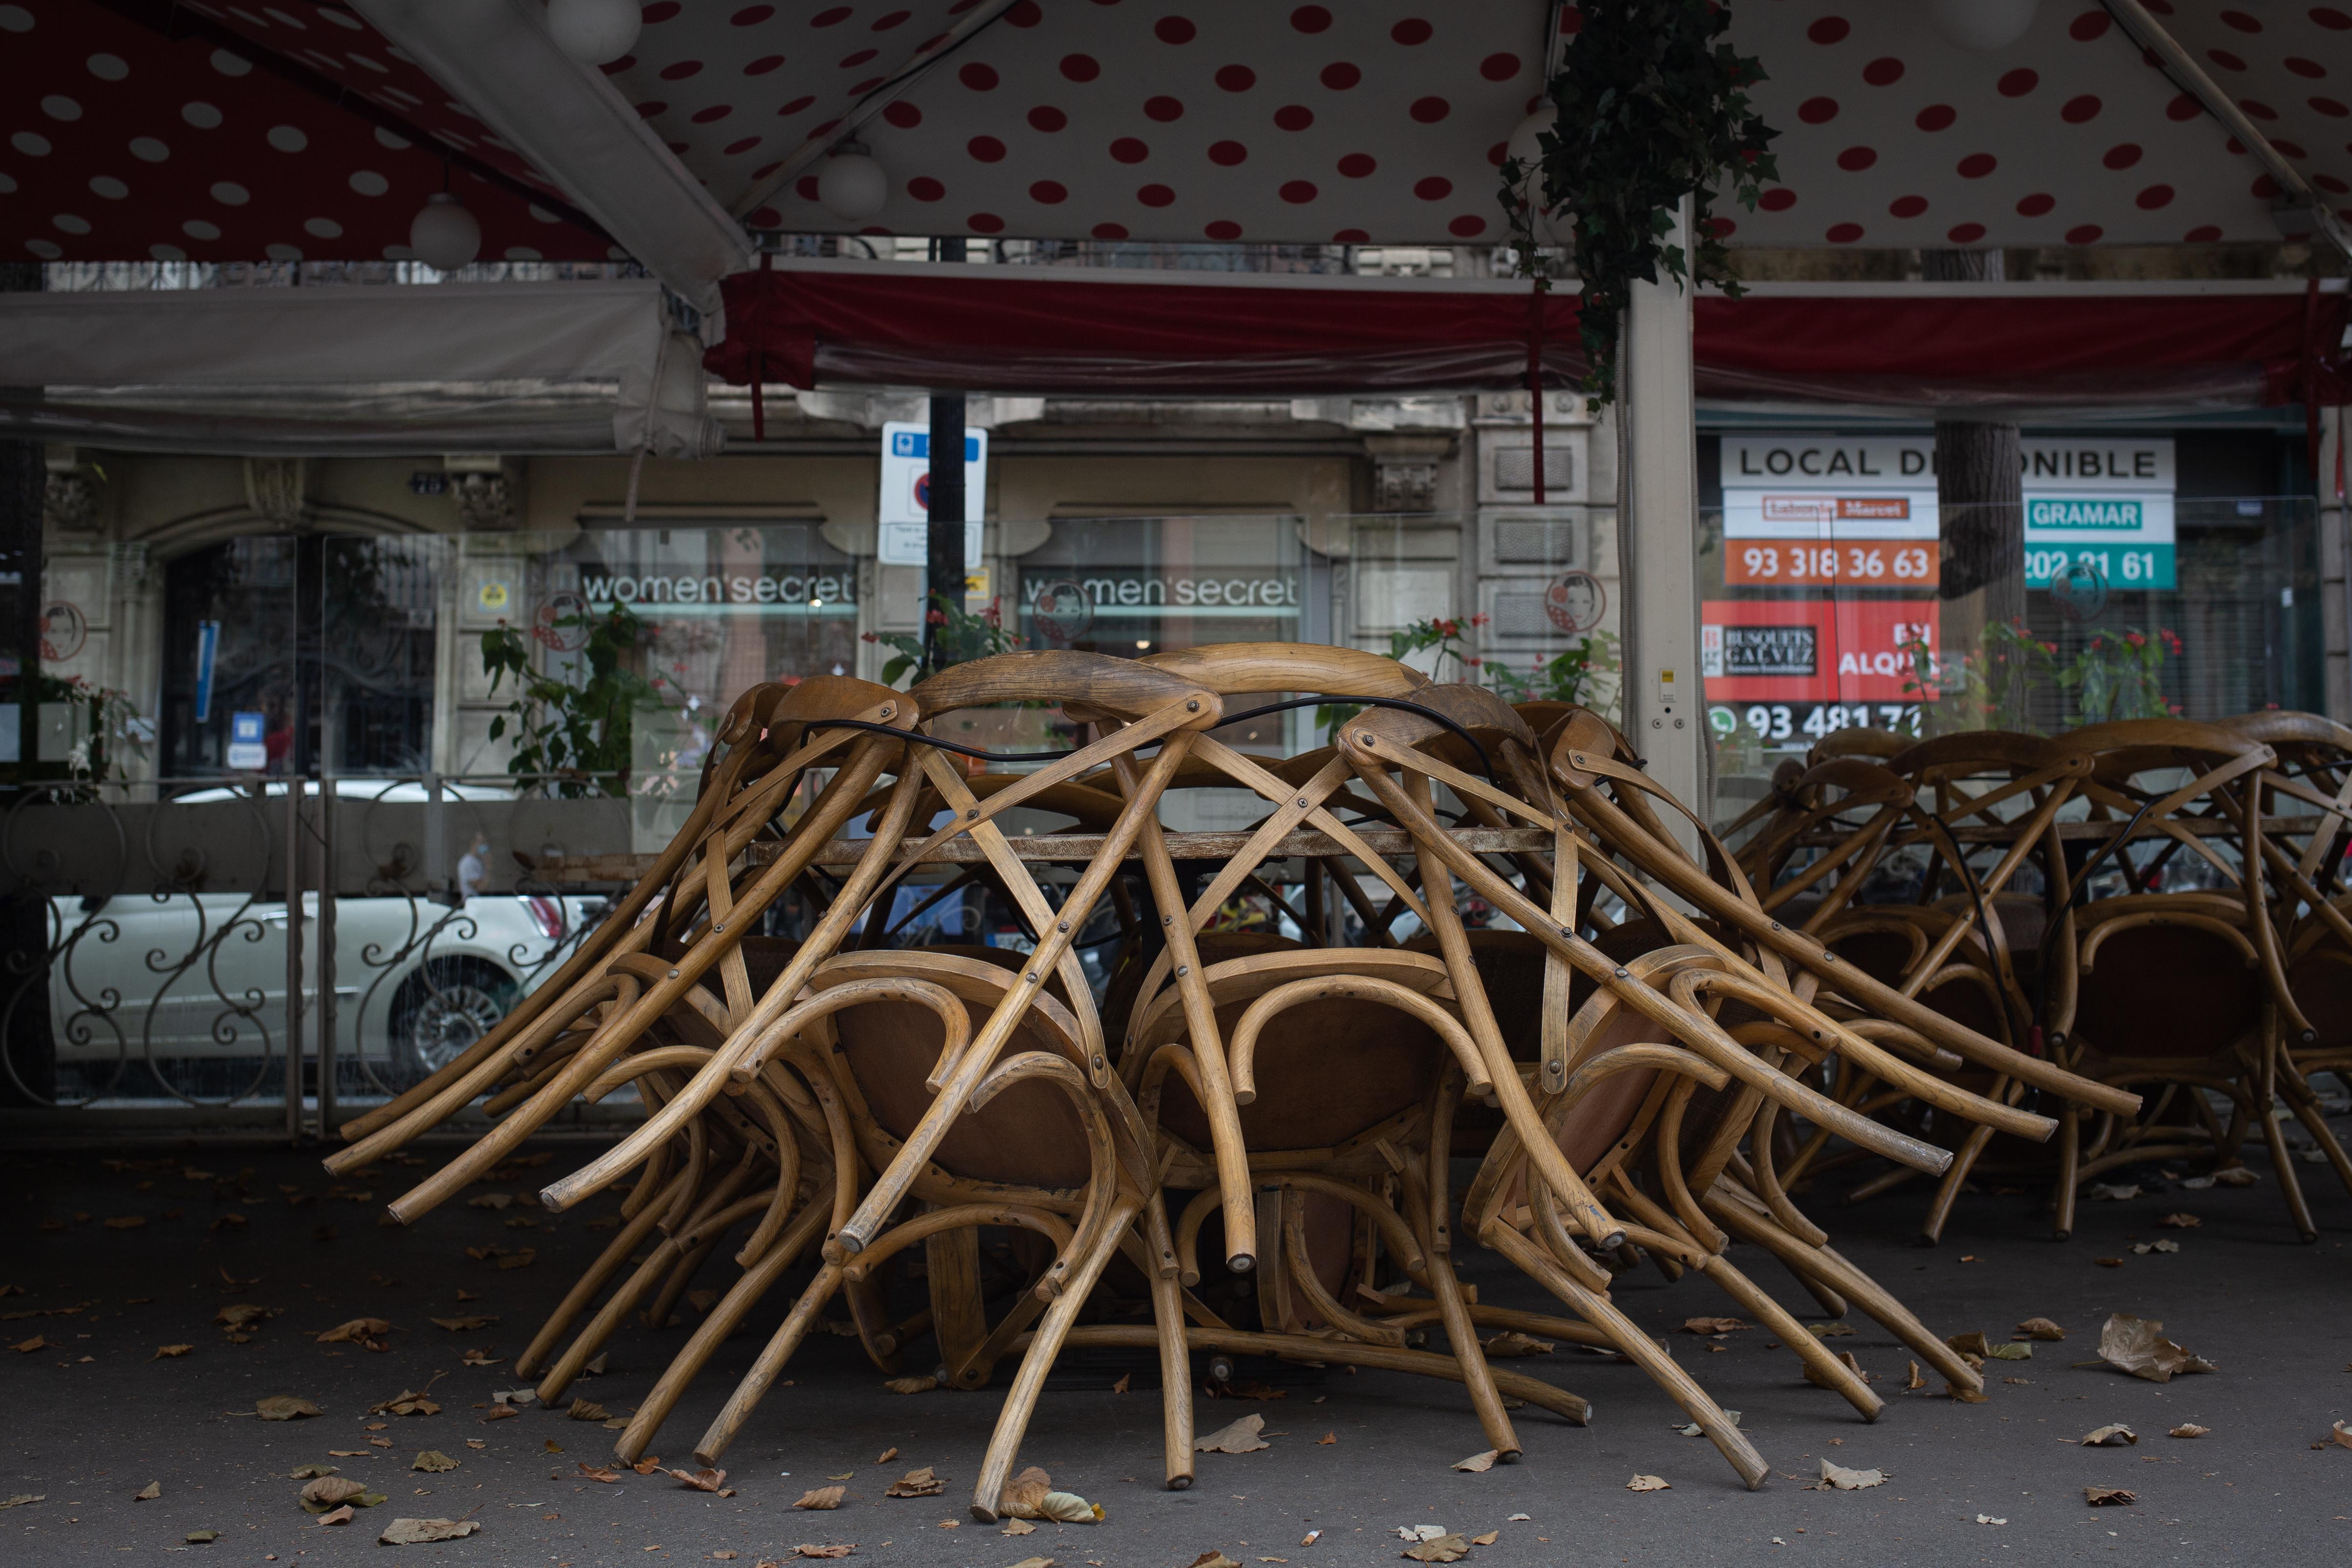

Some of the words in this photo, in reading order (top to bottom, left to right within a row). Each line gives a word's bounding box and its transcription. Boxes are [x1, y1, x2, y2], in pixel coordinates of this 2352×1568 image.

[1740, 448, 1881, 476] LOCAL
[1900, 448, 2157, 478] DINIBLE
[2033, 502, 2139, 526] GRAMAR
[1743, 547, 1780, 578] 93
[1789, 548, 1840, 577] 318
[1848, 548, 1886, 578] 36
[1892, 548, 1930, 578] 63
[2121, 551, 2154, 580] 61
[582, 574, 854, 603] women'secret
[1025, 575, 1298, 605] wmen'secret
[1725, 629, 1814, 648] BUSQUETS
[1725, 647, 1815, 663] GALVEZ
[1745, 705, 1794, 741] 93
[1802, 705, 1871, 740] 481
